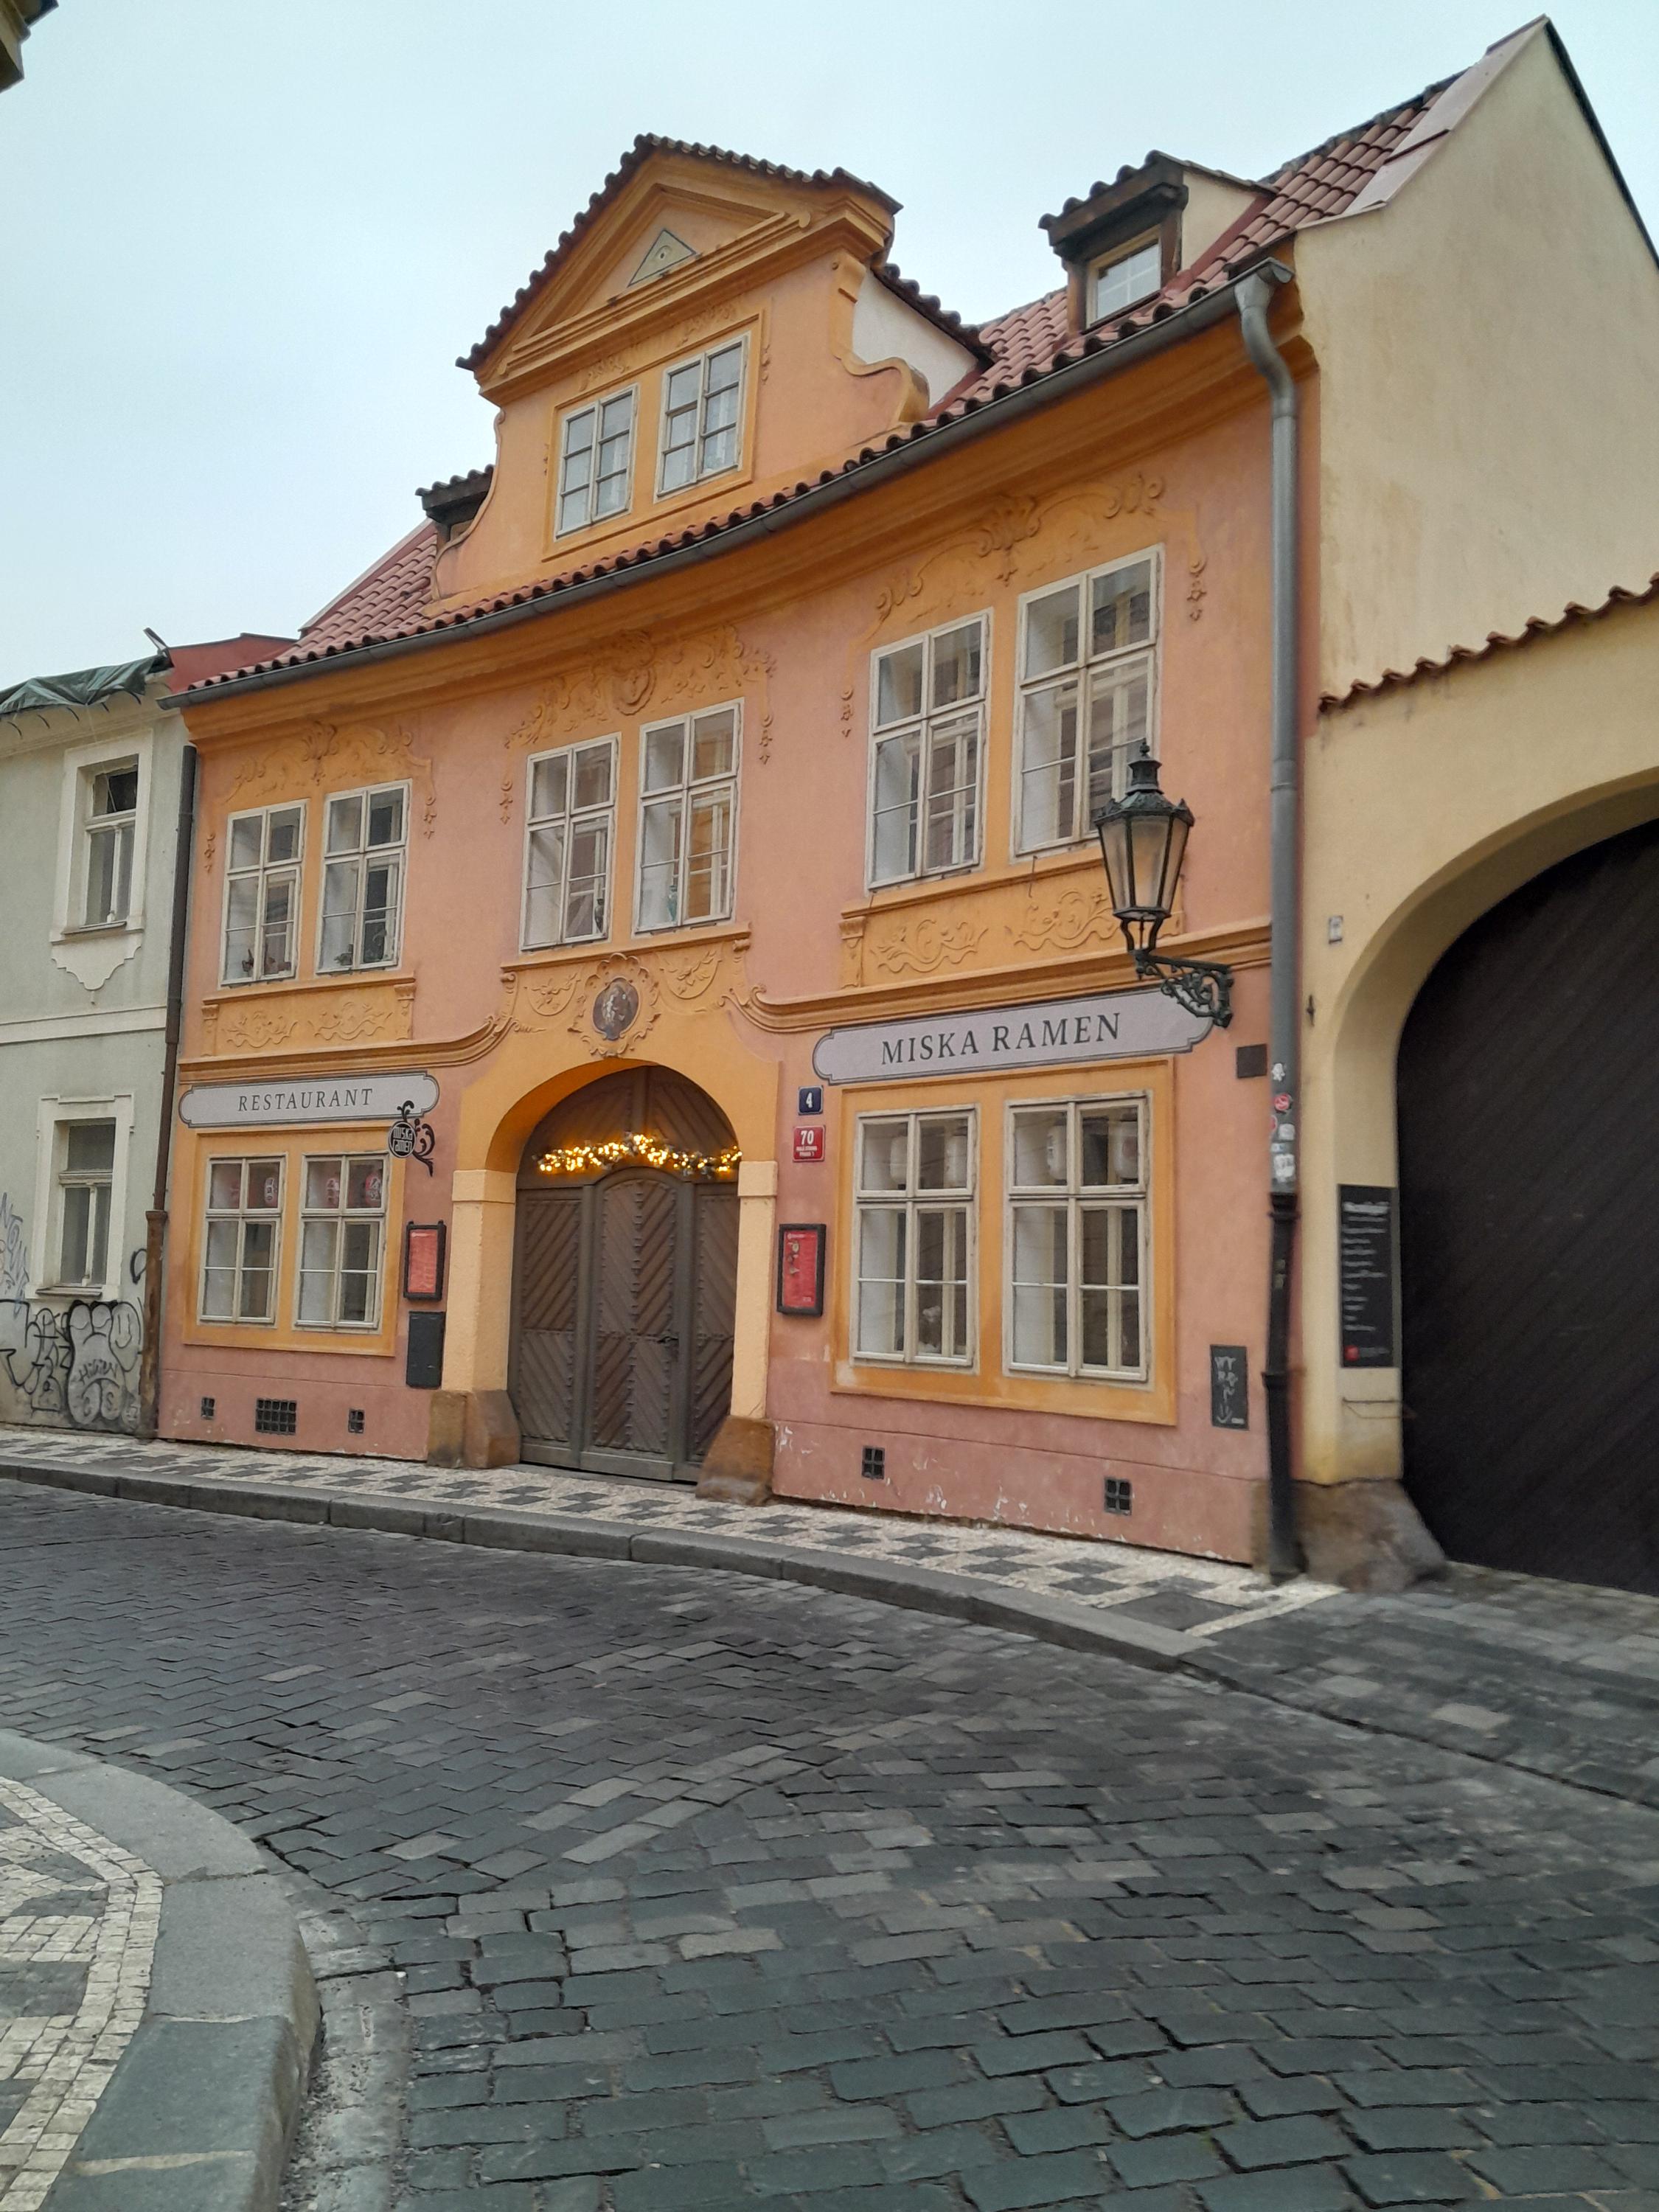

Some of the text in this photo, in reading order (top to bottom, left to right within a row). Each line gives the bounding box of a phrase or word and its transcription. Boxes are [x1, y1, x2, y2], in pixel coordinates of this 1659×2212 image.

[881, 1012, 1121, 1065] MISKA RAMEN
[237, 1088, 373, 1112] RESTAURANT
[805, 1092, 813, 1109] 4
[800, 1130, 815, 1145] 70
